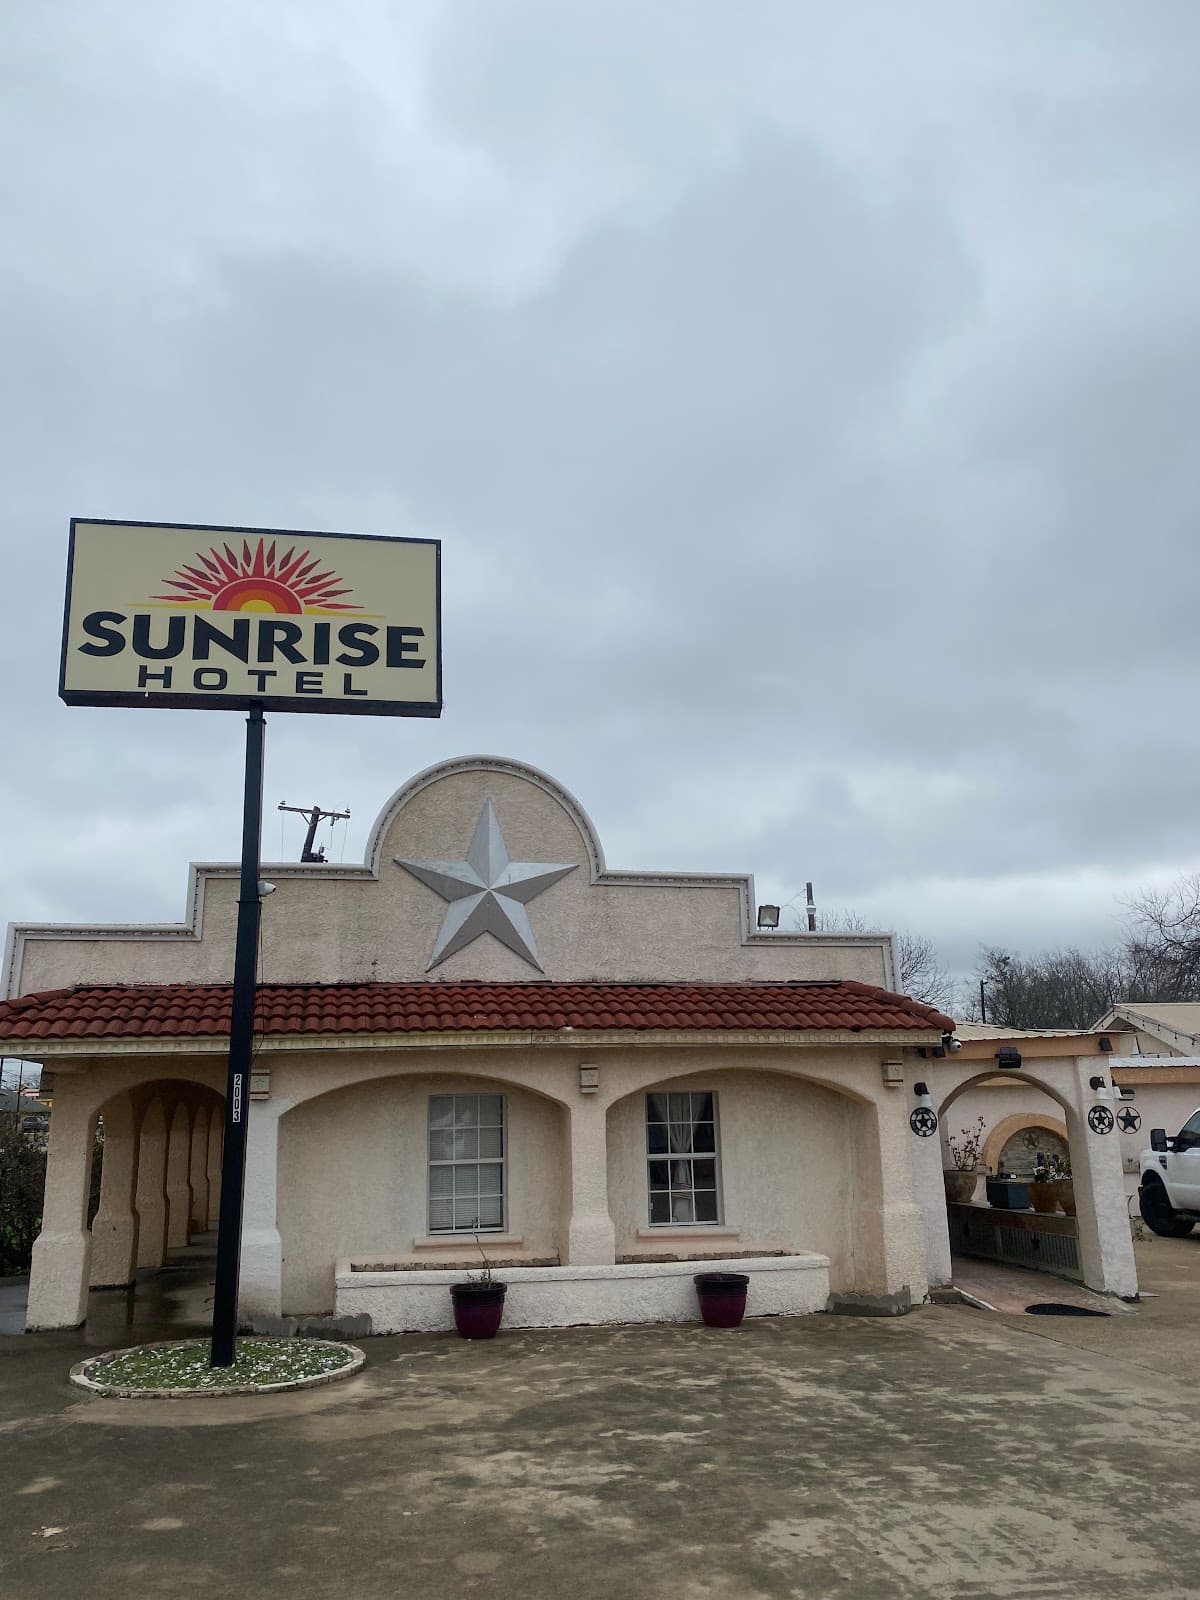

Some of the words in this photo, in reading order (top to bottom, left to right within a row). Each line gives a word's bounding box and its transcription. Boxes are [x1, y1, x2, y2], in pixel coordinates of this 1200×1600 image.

[78, 611, 426, 669] SUNRISE
[138, 665, 368, 696] HOTEL
[233, 1074, 241, 1122] 2003
